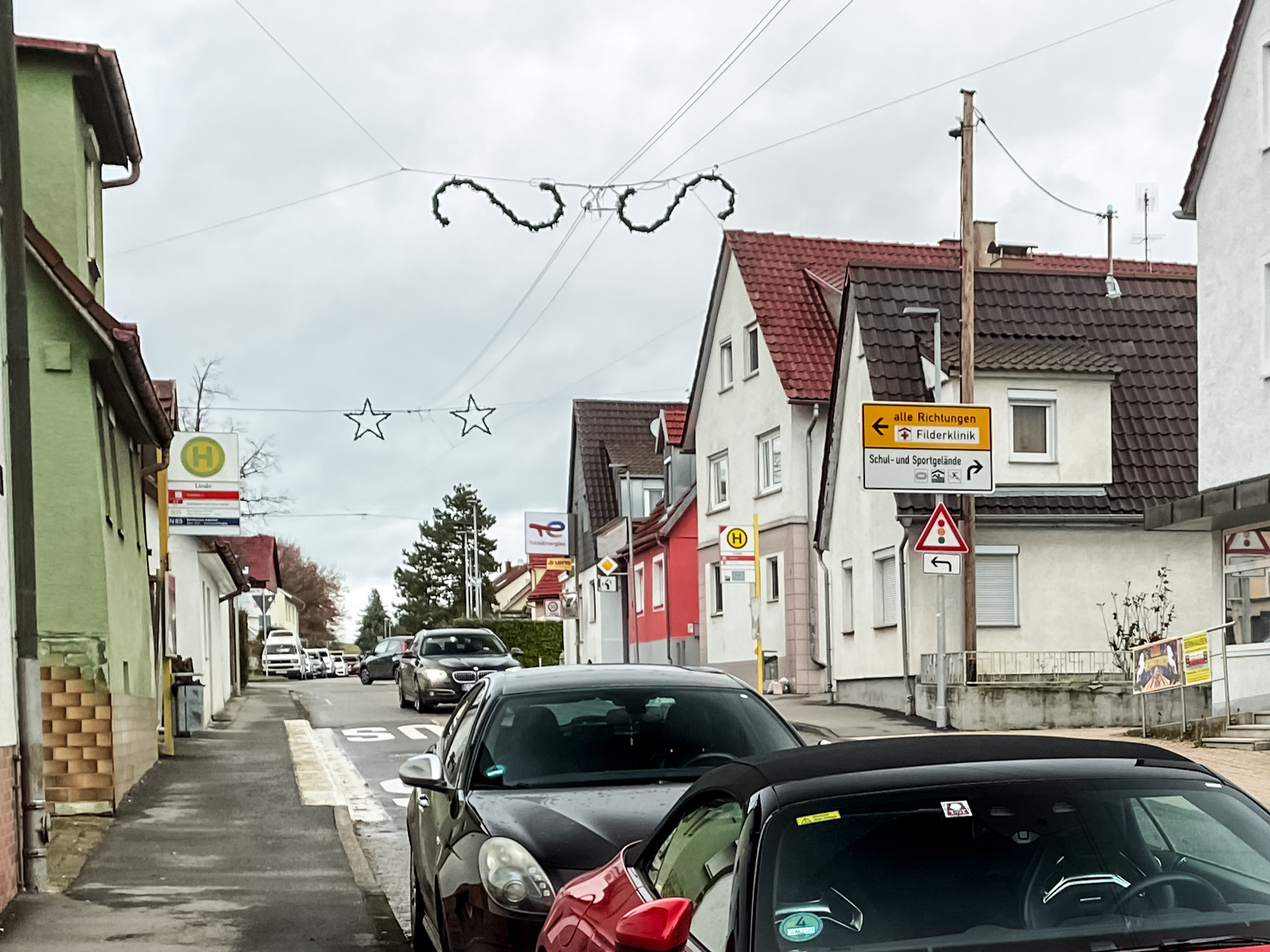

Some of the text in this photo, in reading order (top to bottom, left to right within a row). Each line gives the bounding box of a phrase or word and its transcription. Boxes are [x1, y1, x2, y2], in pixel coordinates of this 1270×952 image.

[894, 412, 976, 425] alle Richtungen
[916, 429, 976, 440] Filderklinik
[192, 446, 213, 468] H
[869, 454, 961, 467] Schul- und Sportgelände
[732, 532, 742, 544] H
[795, 916, 807, 927] 4
